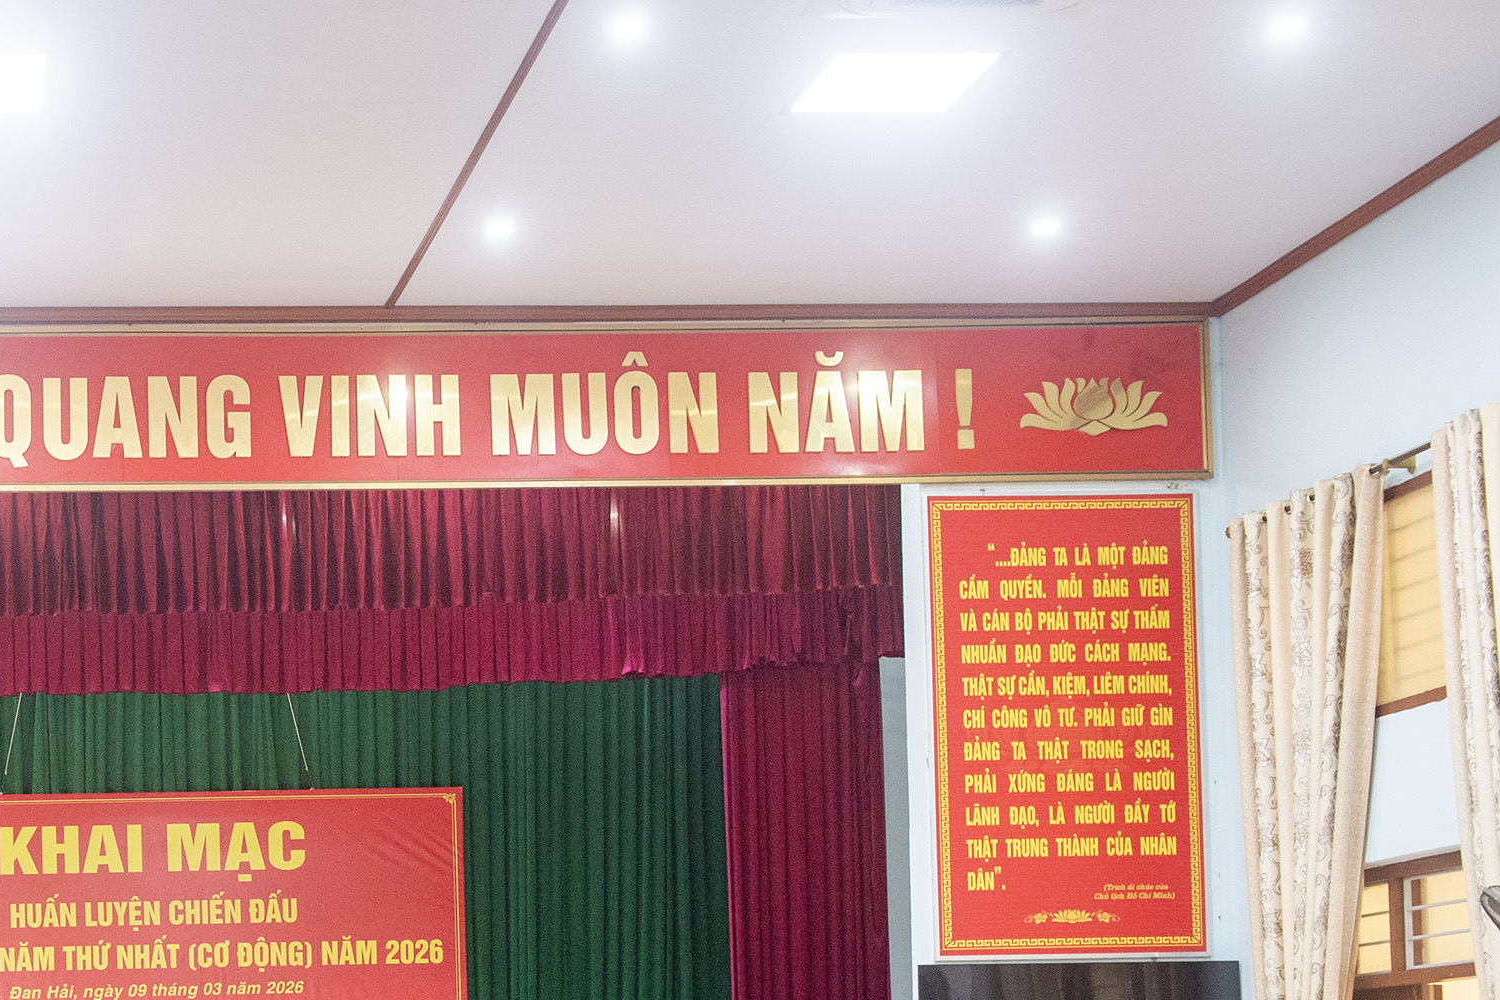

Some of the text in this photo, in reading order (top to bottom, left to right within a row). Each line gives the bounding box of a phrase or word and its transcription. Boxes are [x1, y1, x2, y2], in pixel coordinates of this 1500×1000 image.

[0, 373, 252, 467] QUANG
[278, 373, 461, 459] VINH
[490, 350, 719, 456] MUÔN
[748, 351, 924, 454] NĂM
[955, 366, 974, 451] !
[988, 540, 1167, 569] “....ĐẢNG TA LÀ MỘT ĐẢNG
[960, 573, 1168, 600] CẦM QUYỀN. MỖI ĐẢNG VIÊN
[960, 604, 1169, 634] VÀ CÁN BỘ PHẢI THẬT SỰ THẤM
[961, 638, 1170, 667] NHUẦN ĐẠO ĐỨC CÁCH MẠNG.
[0, 821, 305, 882] KHAI MẠC
[10, 890, 297, 931] HUẤN LUYỆN CHIẾN ĐẤU
[62, 940, 111, 970] THỨ
[117, 935, 181, 970] NHẤT
[189, 940, 230, 970] (CƠ
[237, 936, 313, 972] ĐỘNG)
[322, 938, 377, 965] NĂM
[386, 938, 444, 965] 2026
[47, 984, 77, 1000] Hải,
[83, 984, 123, 1000] ngày
[128, 984, 147, 997] 09
[152, 983, 198, 999] tháng
[204, 983, 222, 995] 03
[227, 982, 261, 995] năm
[266, 981, 304, 994] 2026
